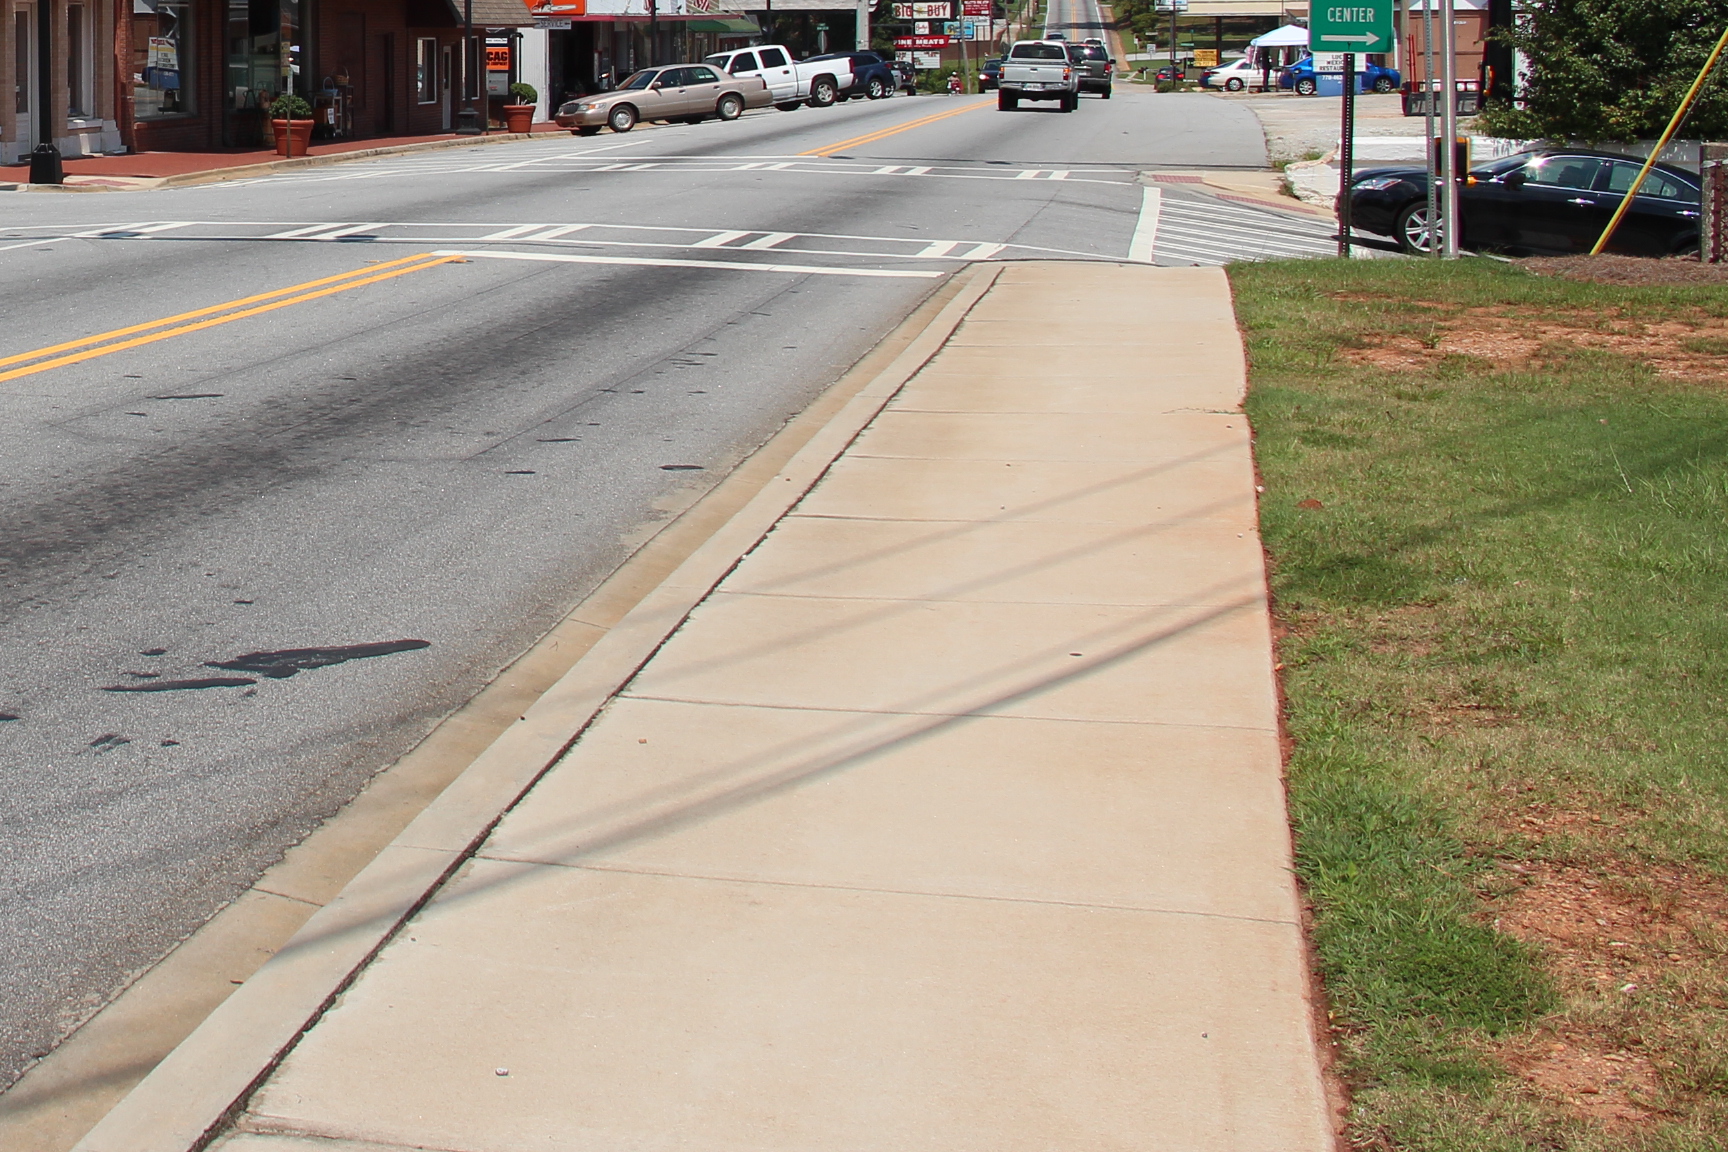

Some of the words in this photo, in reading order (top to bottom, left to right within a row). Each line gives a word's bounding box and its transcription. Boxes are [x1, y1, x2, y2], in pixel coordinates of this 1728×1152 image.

[894, 5, 912, 17] BIG
[927, 4, 947, 16] BUY
[1327, 7, 1374, 23] CENTER
[540, 20, 564, 28] SERVICE
[486, 51, 508, 62] CAG
